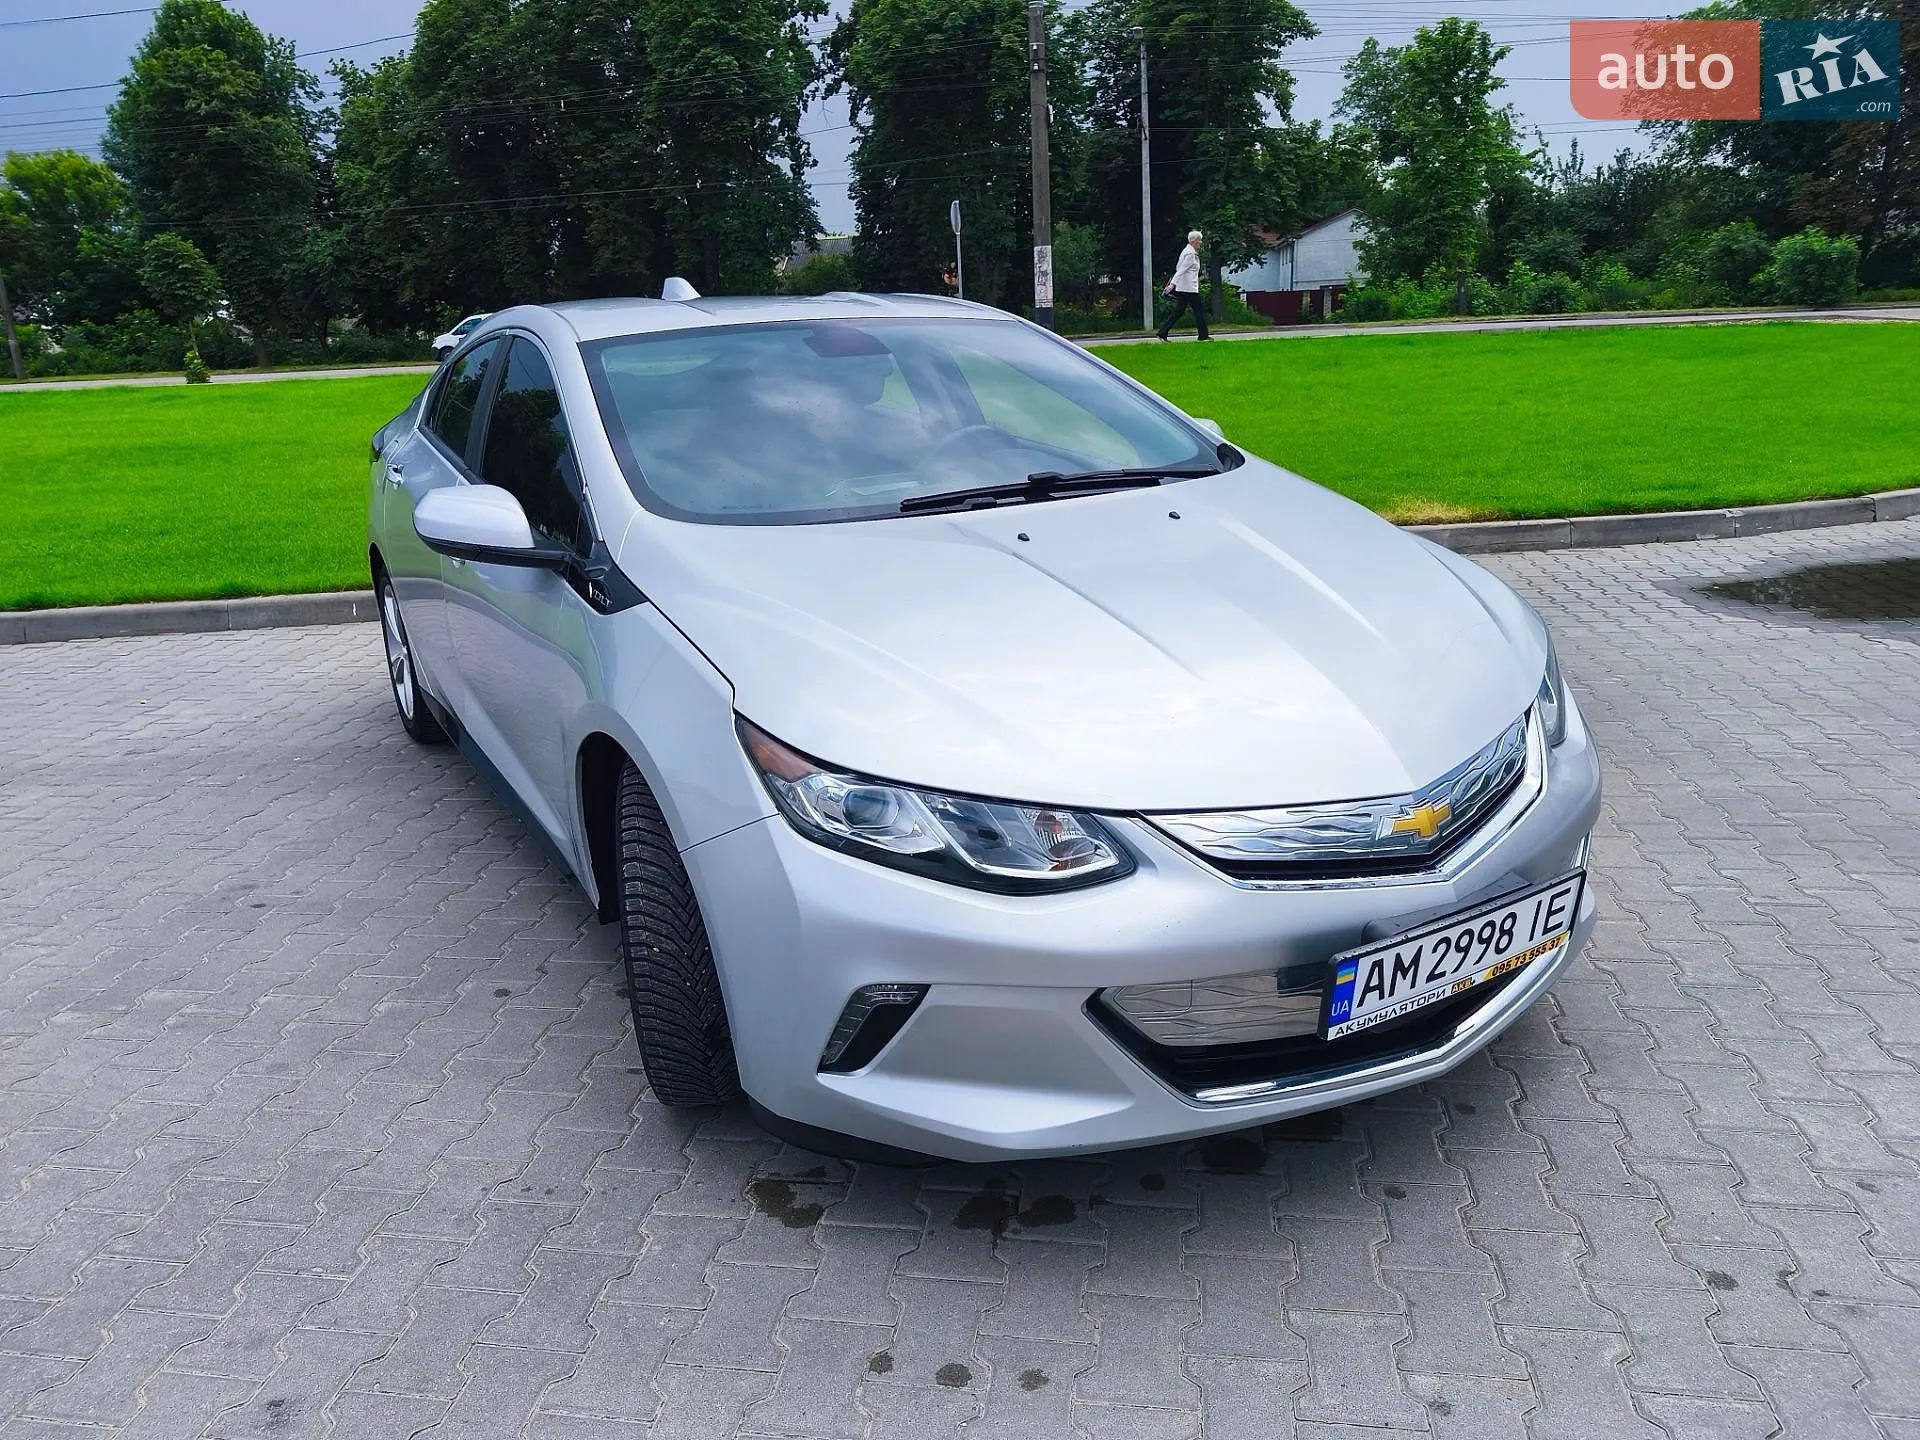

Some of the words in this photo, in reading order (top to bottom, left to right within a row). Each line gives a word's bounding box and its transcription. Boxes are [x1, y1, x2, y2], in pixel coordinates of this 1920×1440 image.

[1528, 887, 1572, 942] IE
[1331, 999, 1350, 1017] UA
[1334, 988, 1447, 1037] АКУМУЛЯТОРИ
[1491, 959, 1513, 977] 095
[1514, 953, 1527, 967] 73
[1528, 943, 1547, 960] 555
[1548, 936, 1561, 951] 37
